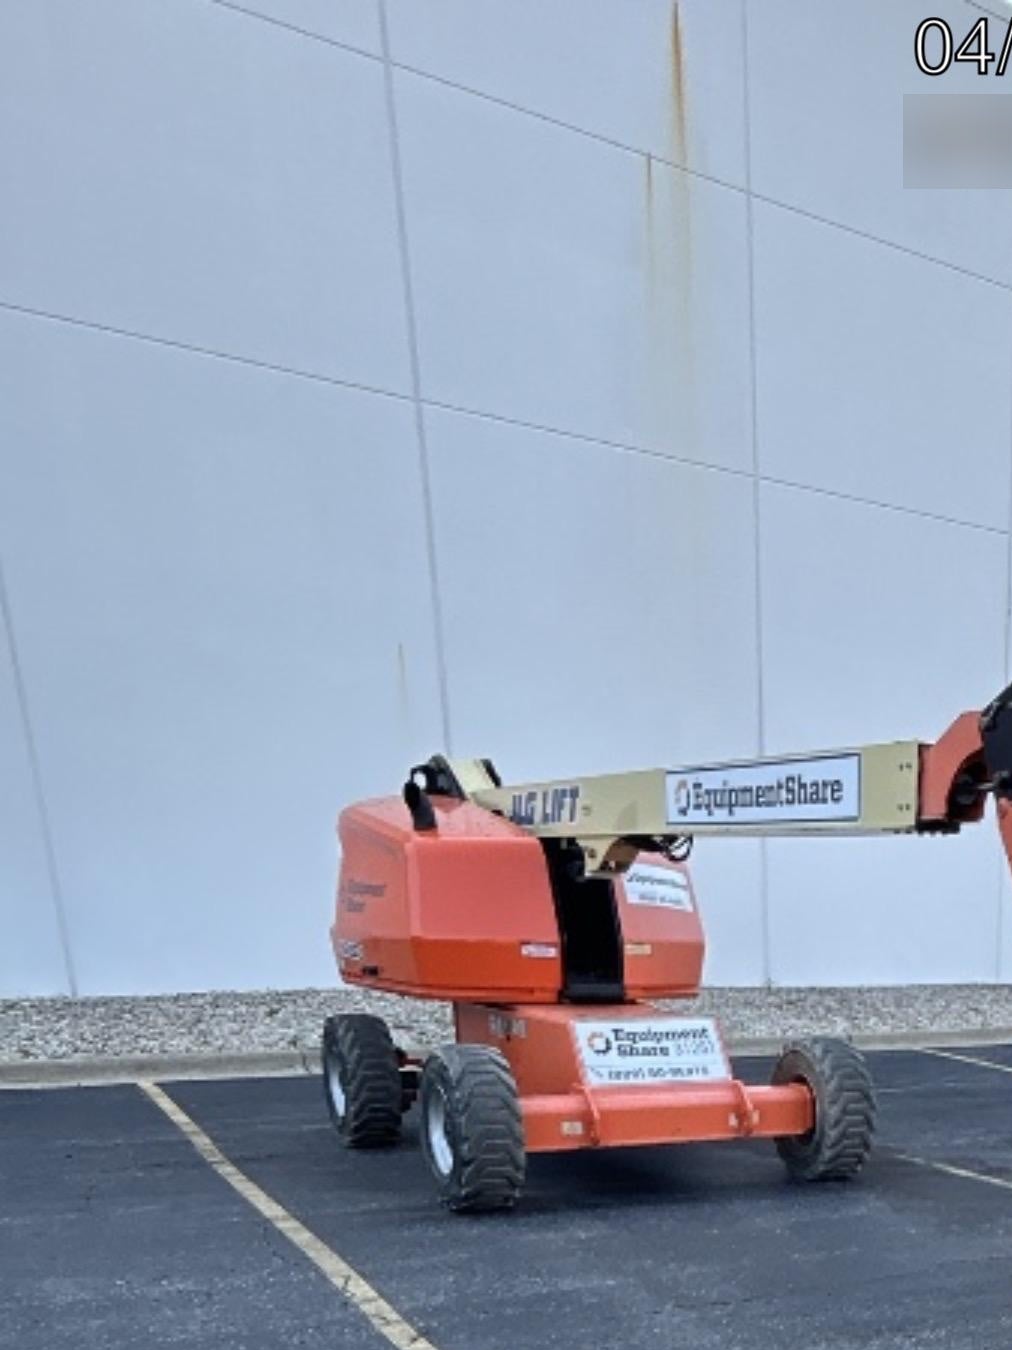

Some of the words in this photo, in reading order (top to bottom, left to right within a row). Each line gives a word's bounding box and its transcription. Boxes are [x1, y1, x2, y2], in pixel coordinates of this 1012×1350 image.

[510, 791, 537, 825] JLG
[542, 785, 579, 825] LIFT
[692, 774, 844, 816] EquipmentShare
[611, 1027, 709, 1044] Equipment
[616, 1042, 671, 1057] Share
